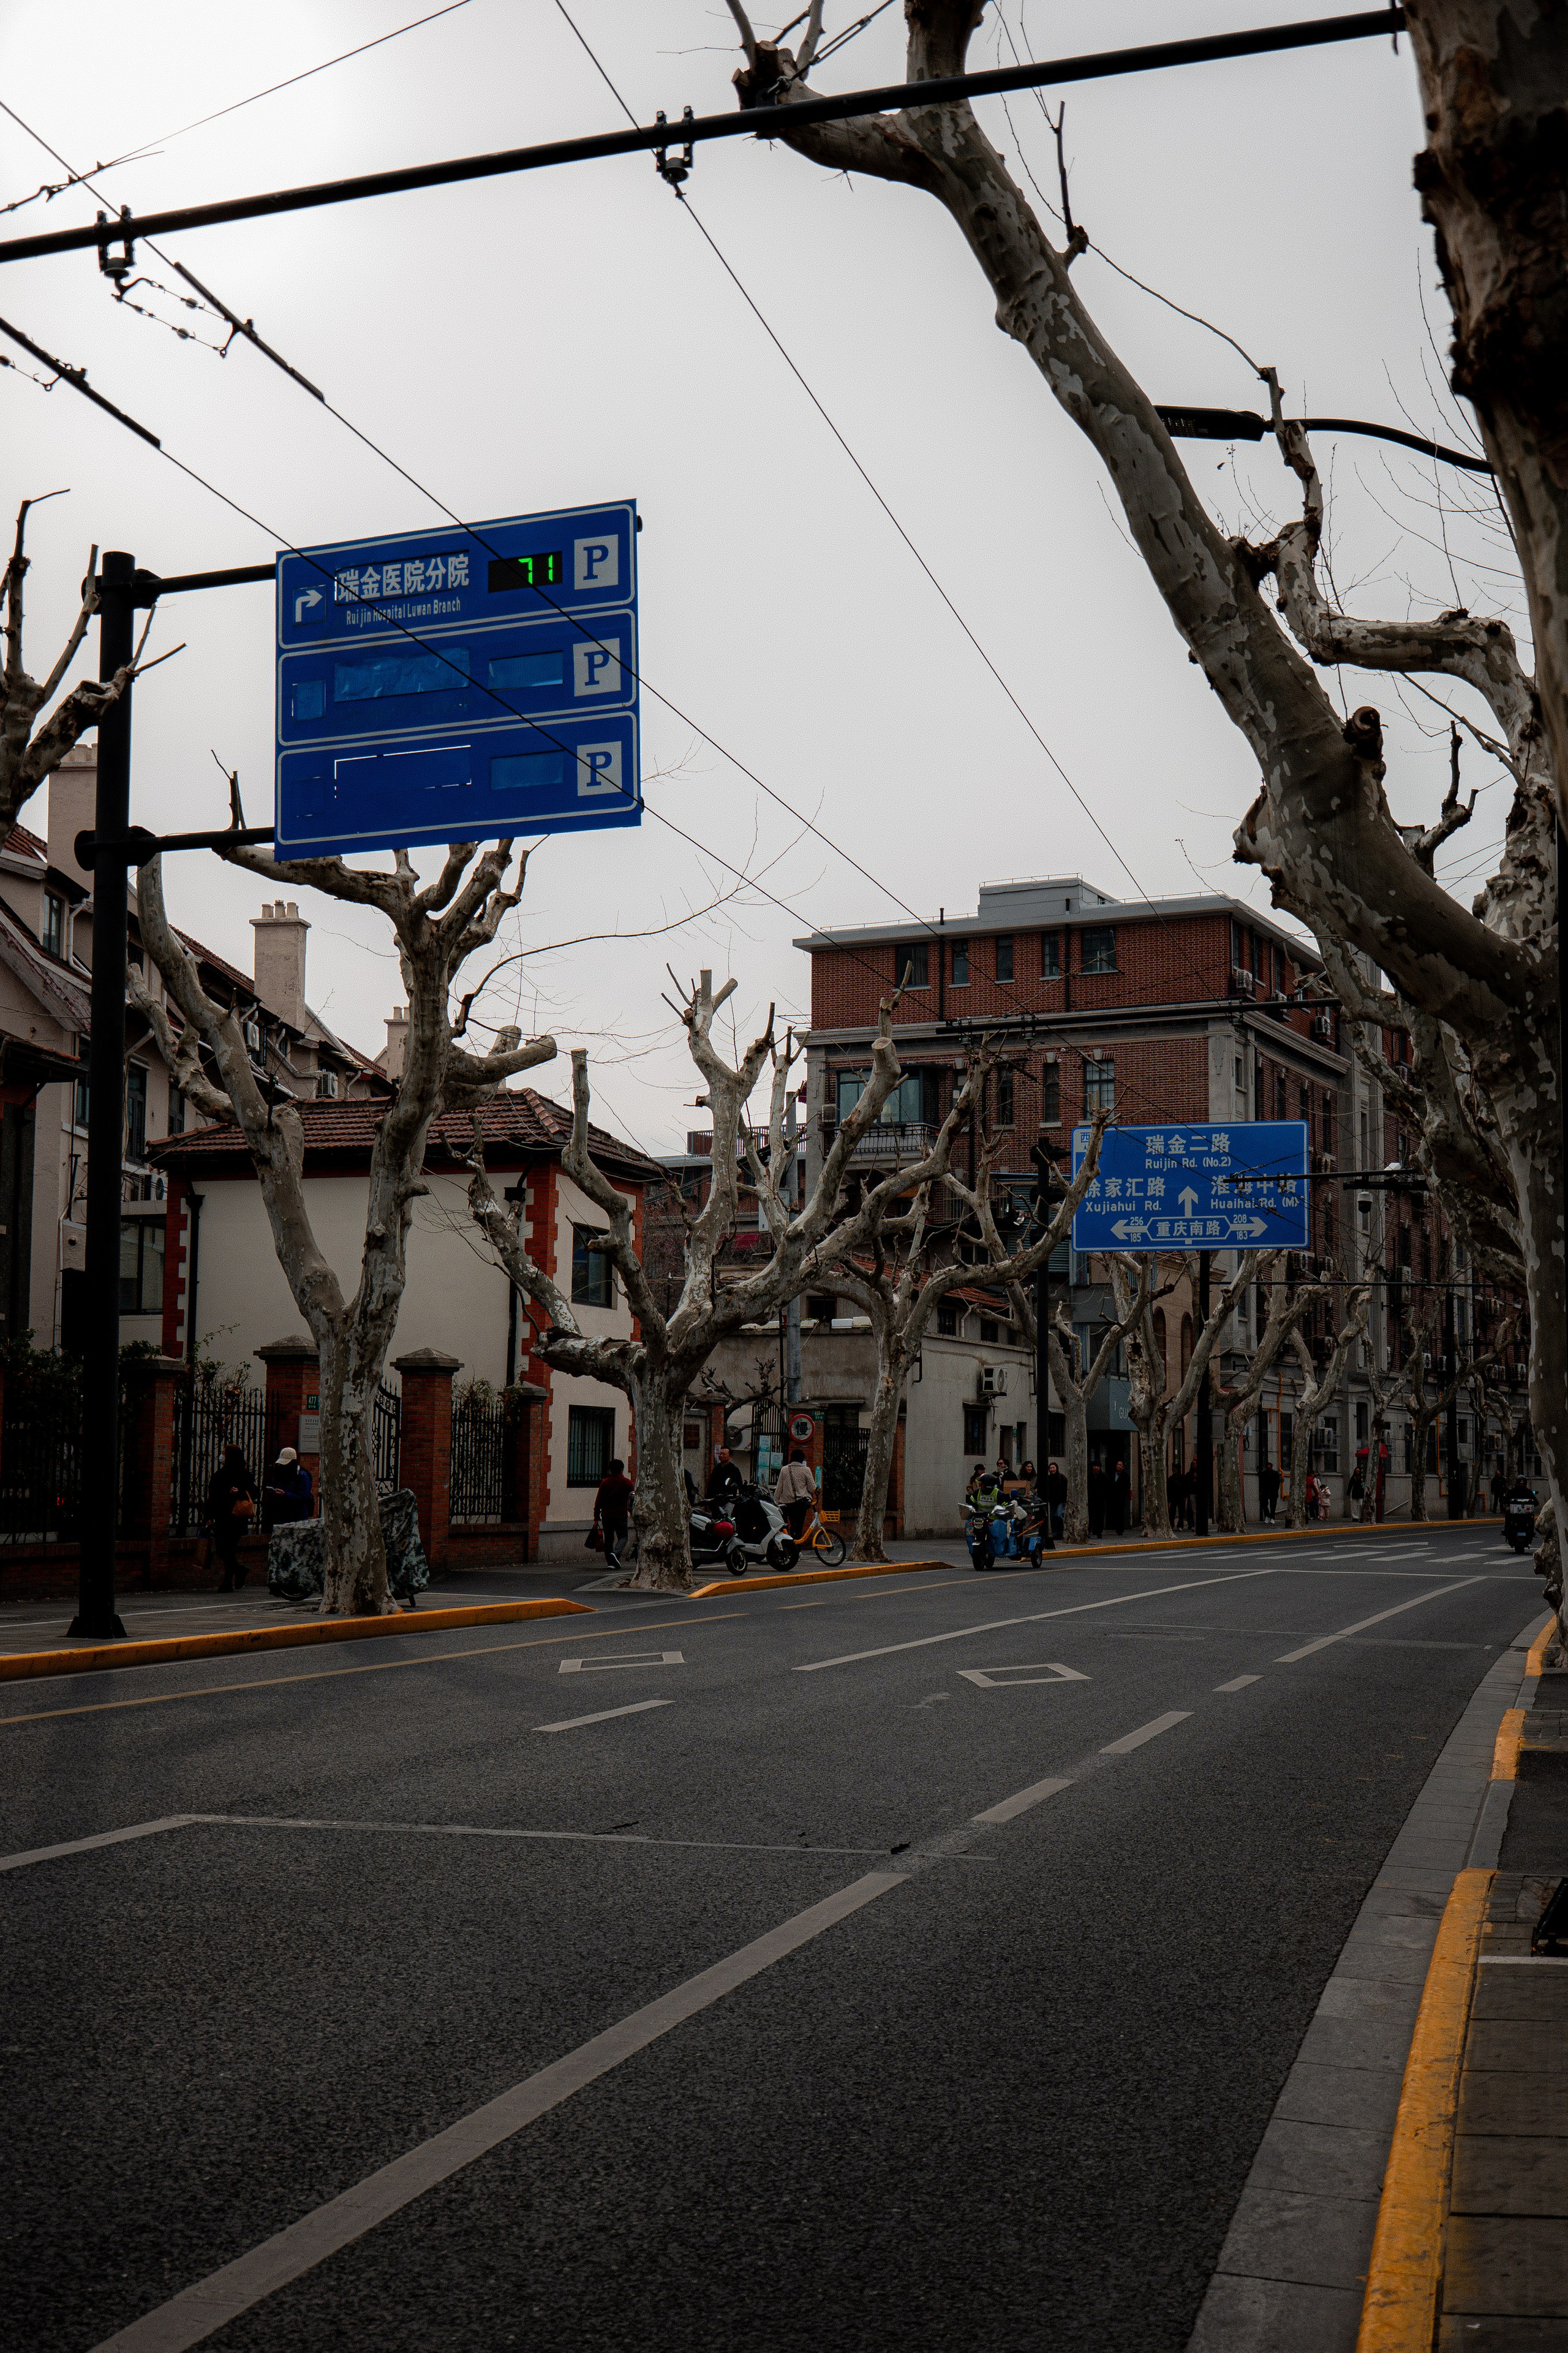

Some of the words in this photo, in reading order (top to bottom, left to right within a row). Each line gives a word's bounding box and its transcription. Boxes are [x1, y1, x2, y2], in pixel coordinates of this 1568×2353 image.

[518, 554, 553, 584] 71
[583, 544, 609, 580] P
[339, 554, 469, 602] 瑞金医院分院
[347, 609, 371, 628] Ruijin
[373, 604, 405, 623] Hospital
[407, 601, 431, 618] Luwan
[434, 597, 460, 614] Branch
[584, 650, 609, 686] P
[586, 750, 611, 787] P
[1080, 1132, 1092, 1143] 西
[1146, 1133, 1231, 1155] 瑞金二路
[1145, 1157, 1177, 1171] Ruijin
[1182, 1157, 1197, 1168] Rd.
[1202, 1157, 1231, 1168] (No.2)
[1085, 1177, 1166, 1198] 徐家汇路
[1211, 1174, 1297, 1195] 淮海中路
[1085, 1201, 1136, 1215] Xujiahui
[1145, 1201, 1161, 1210] Rd.
[1211, 1198, 1255, 1209] Huaihai
[1261, 1197, 1277, 1208] Rd.
[1282, 1196, 1299, 1207] (M)
[1130, 1217, 1144, 1226] 256
[1233, 1214, 1247, 1223] 208
[1156, 1220, 1221, 1237] 重庆南路
[1237, 1231, 1248, 1240] 183
[1130, 1233, 1141, 1242] 185
[796, 1421, 808, 1436] 慢
